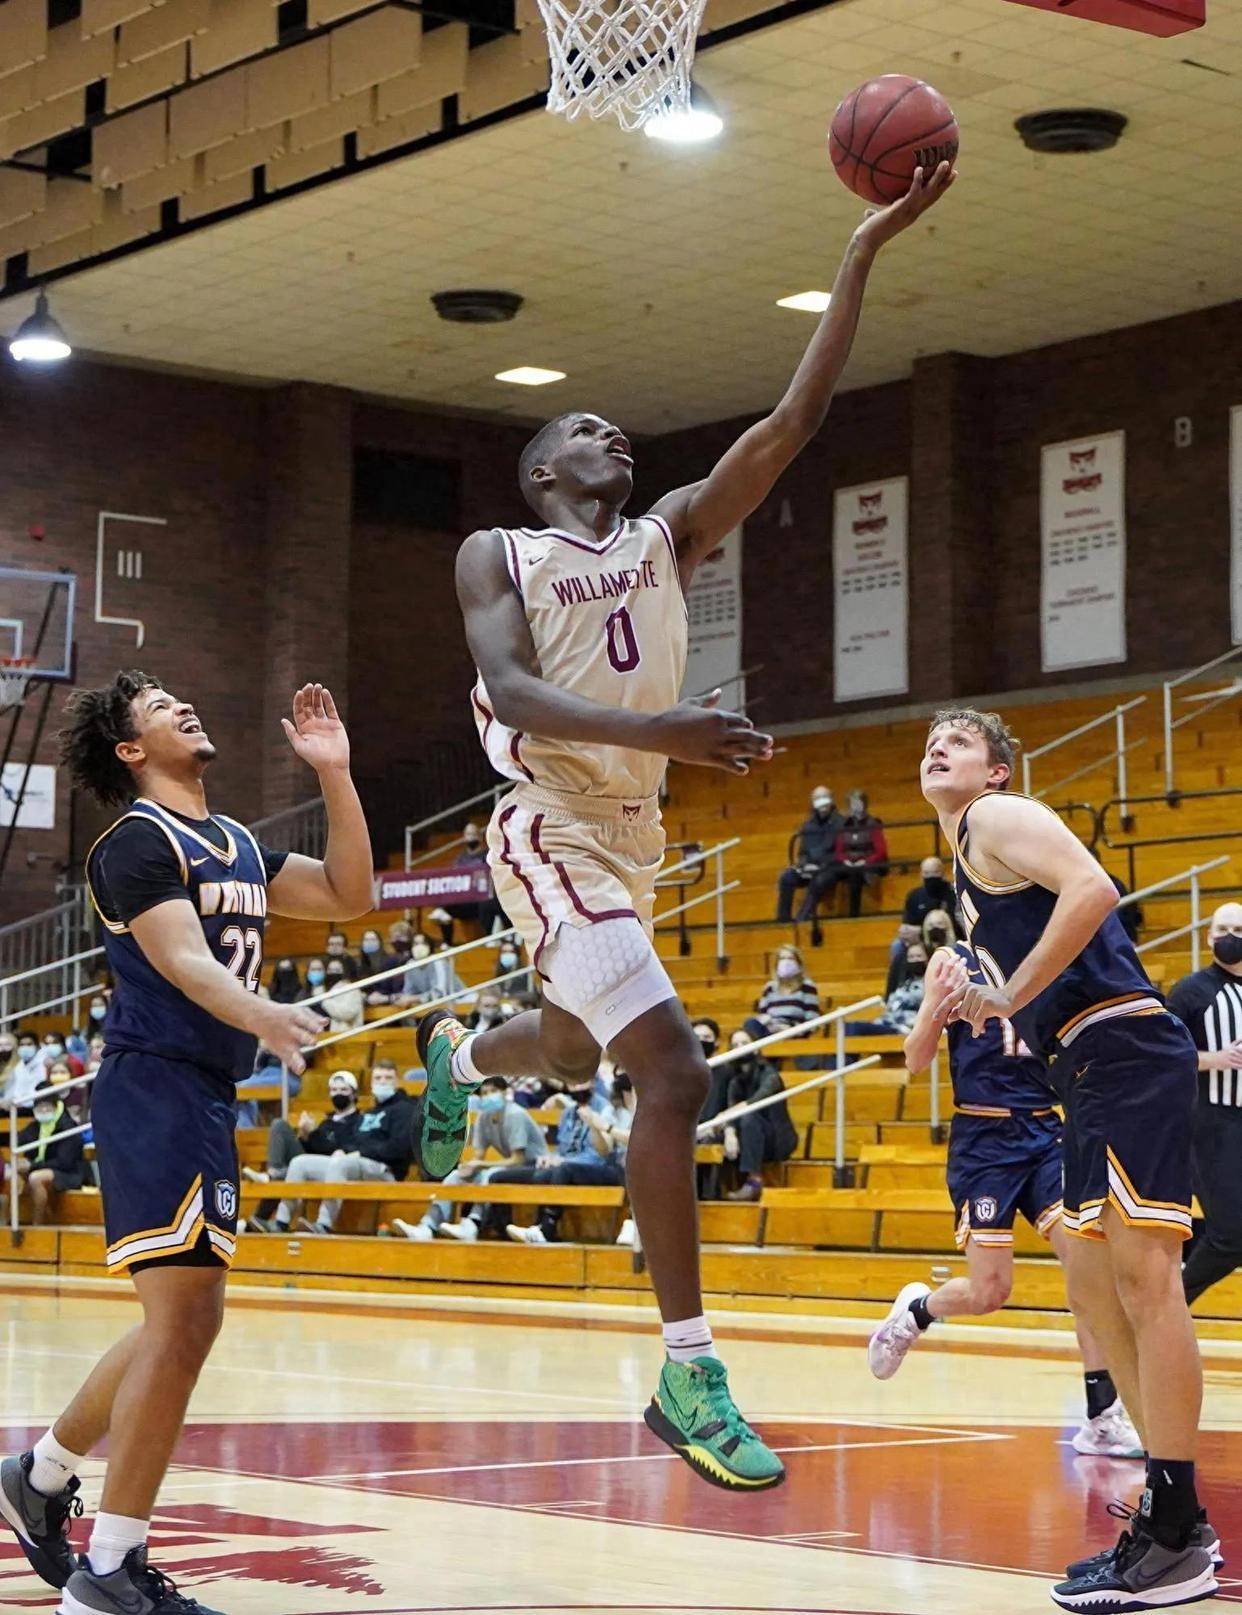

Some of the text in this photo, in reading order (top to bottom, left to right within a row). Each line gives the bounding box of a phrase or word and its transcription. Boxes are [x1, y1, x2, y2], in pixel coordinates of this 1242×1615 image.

[551, 560, 659, 607] WILLAMETTE
[605, 605, 641, 674] 0
[383, 879, 427, 899] STUDENT
[427, 875, 471, 895] SECTION
[221, 925, 262, 991] 22
